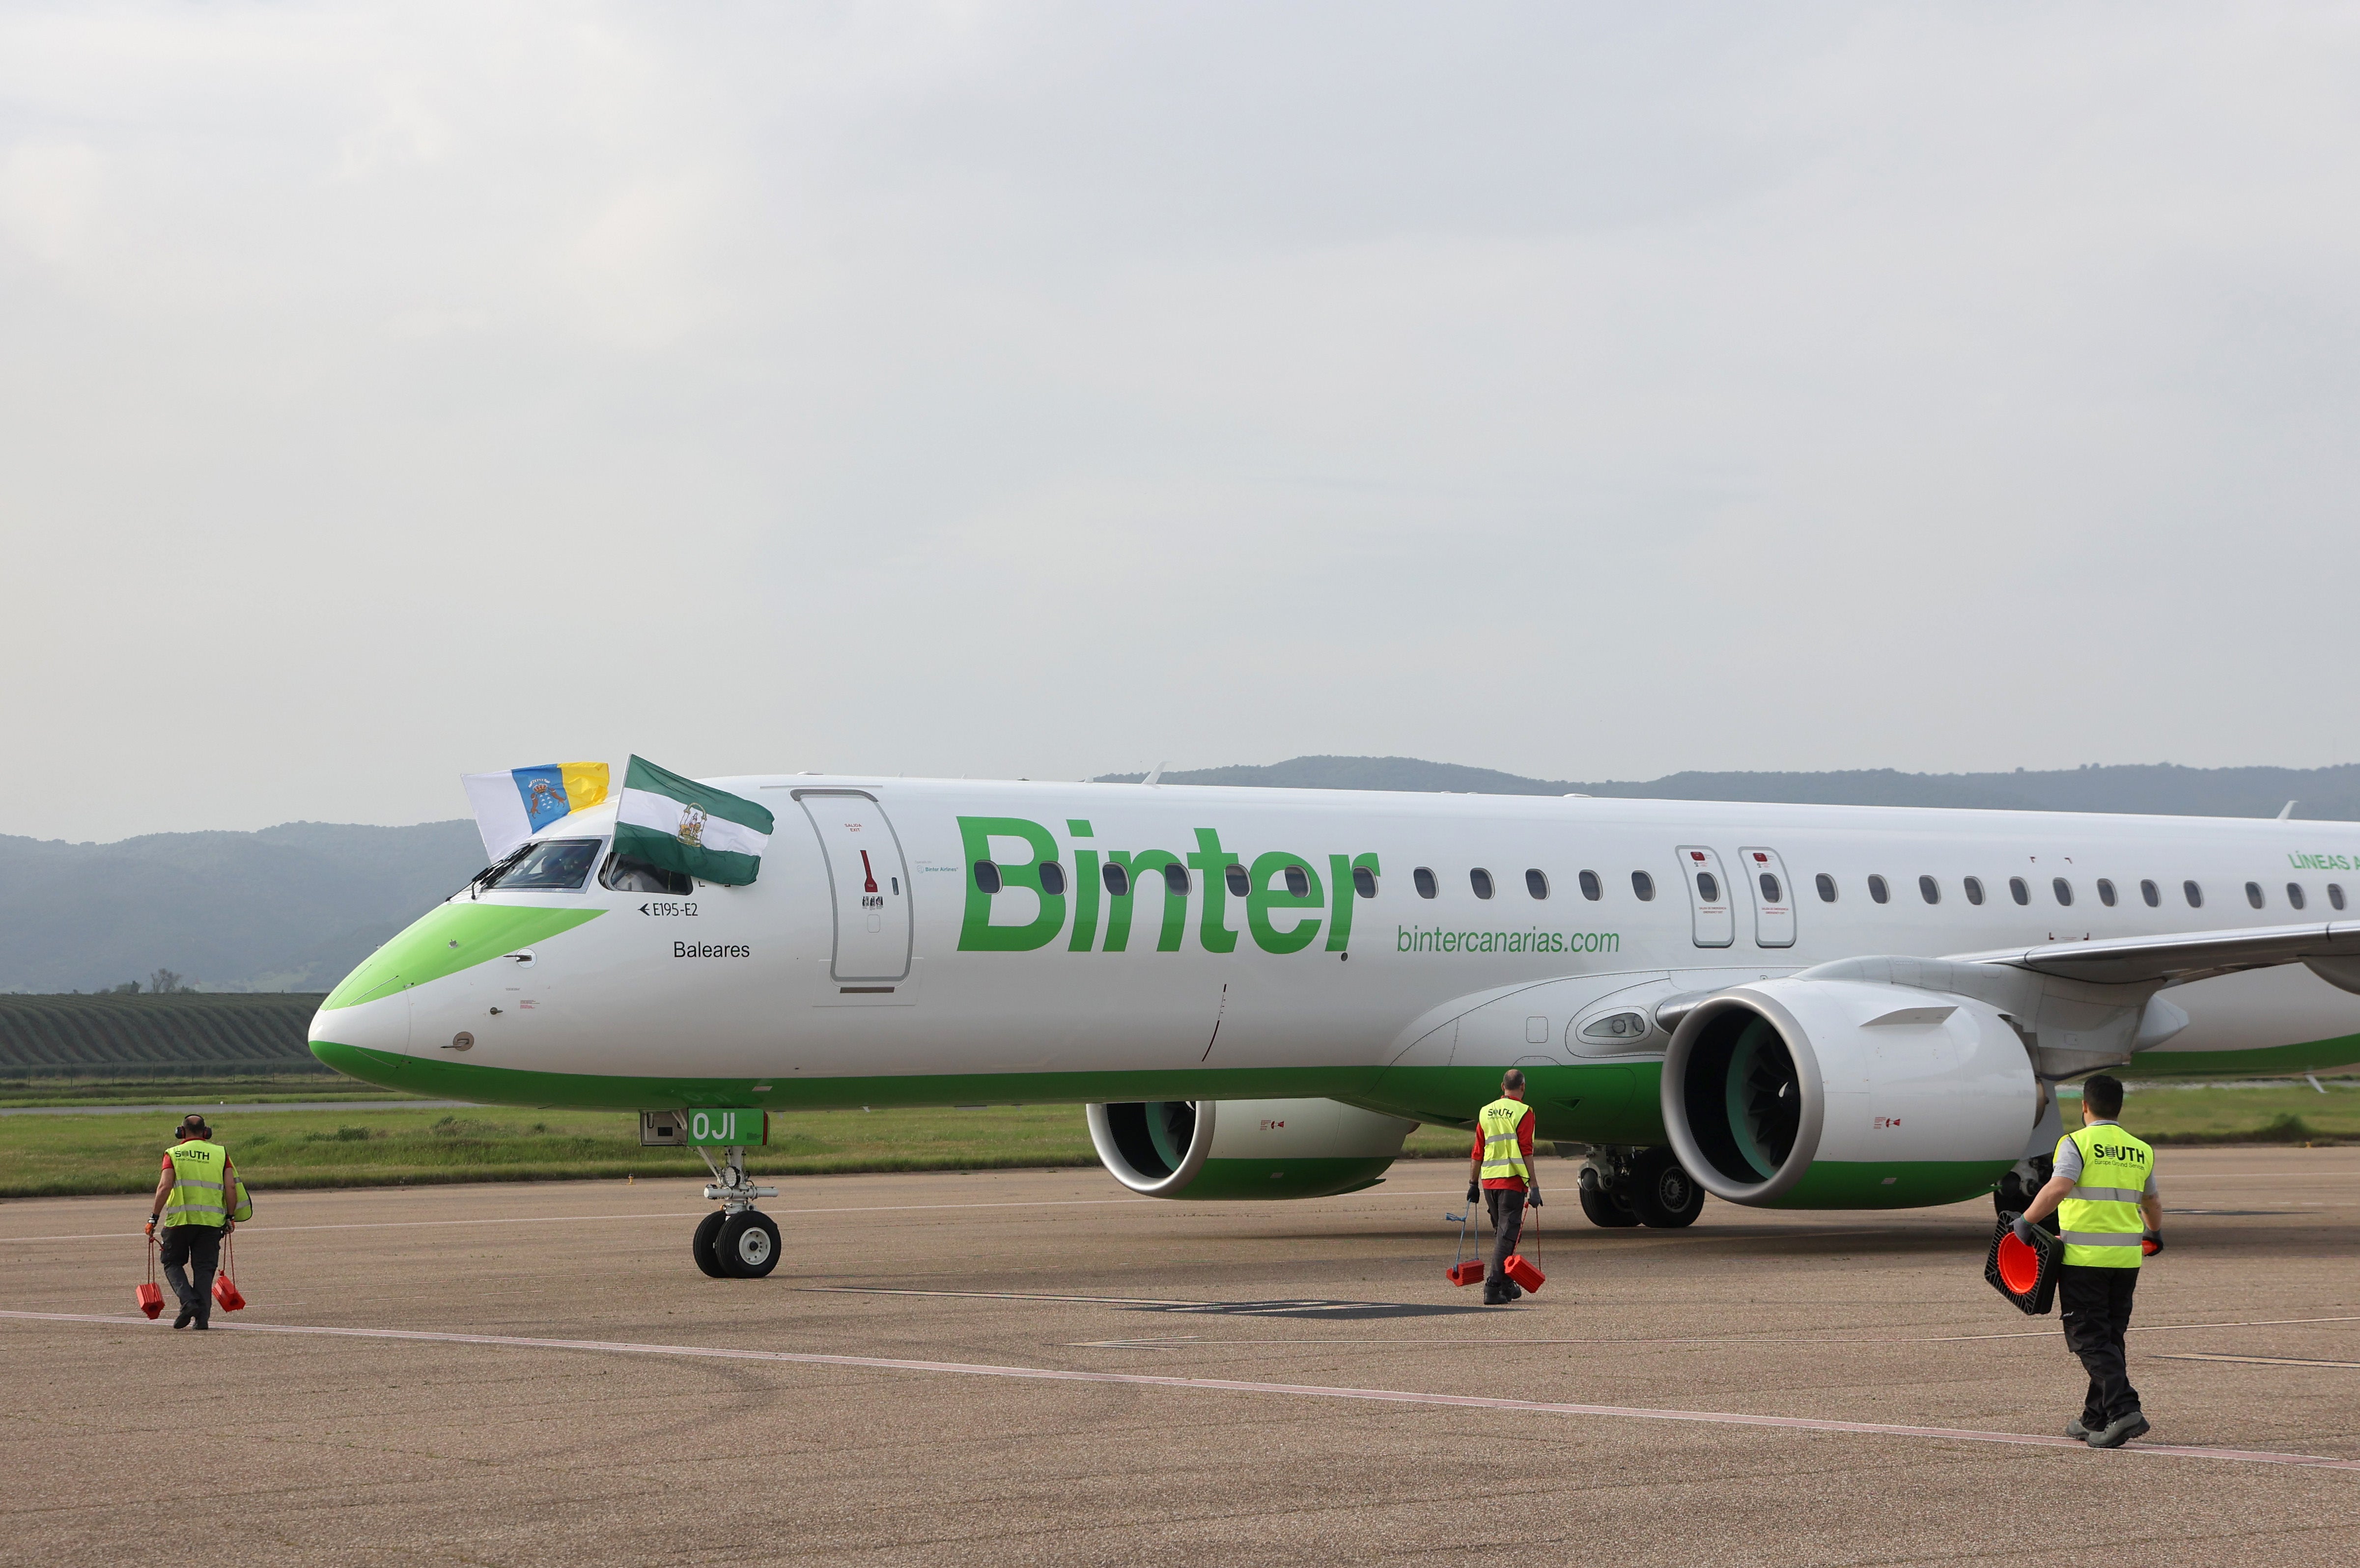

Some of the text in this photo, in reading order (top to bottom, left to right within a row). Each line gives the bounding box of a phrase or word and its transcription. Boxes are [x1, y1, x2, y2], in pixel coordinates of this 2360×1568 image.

[956, 816, 1381, 954] Binter
[653, 903, 698, 916] E195-E2
[674, 941, 750, 957] Baleares
[1397, 925, 1620, 952] bintercanarias.com
